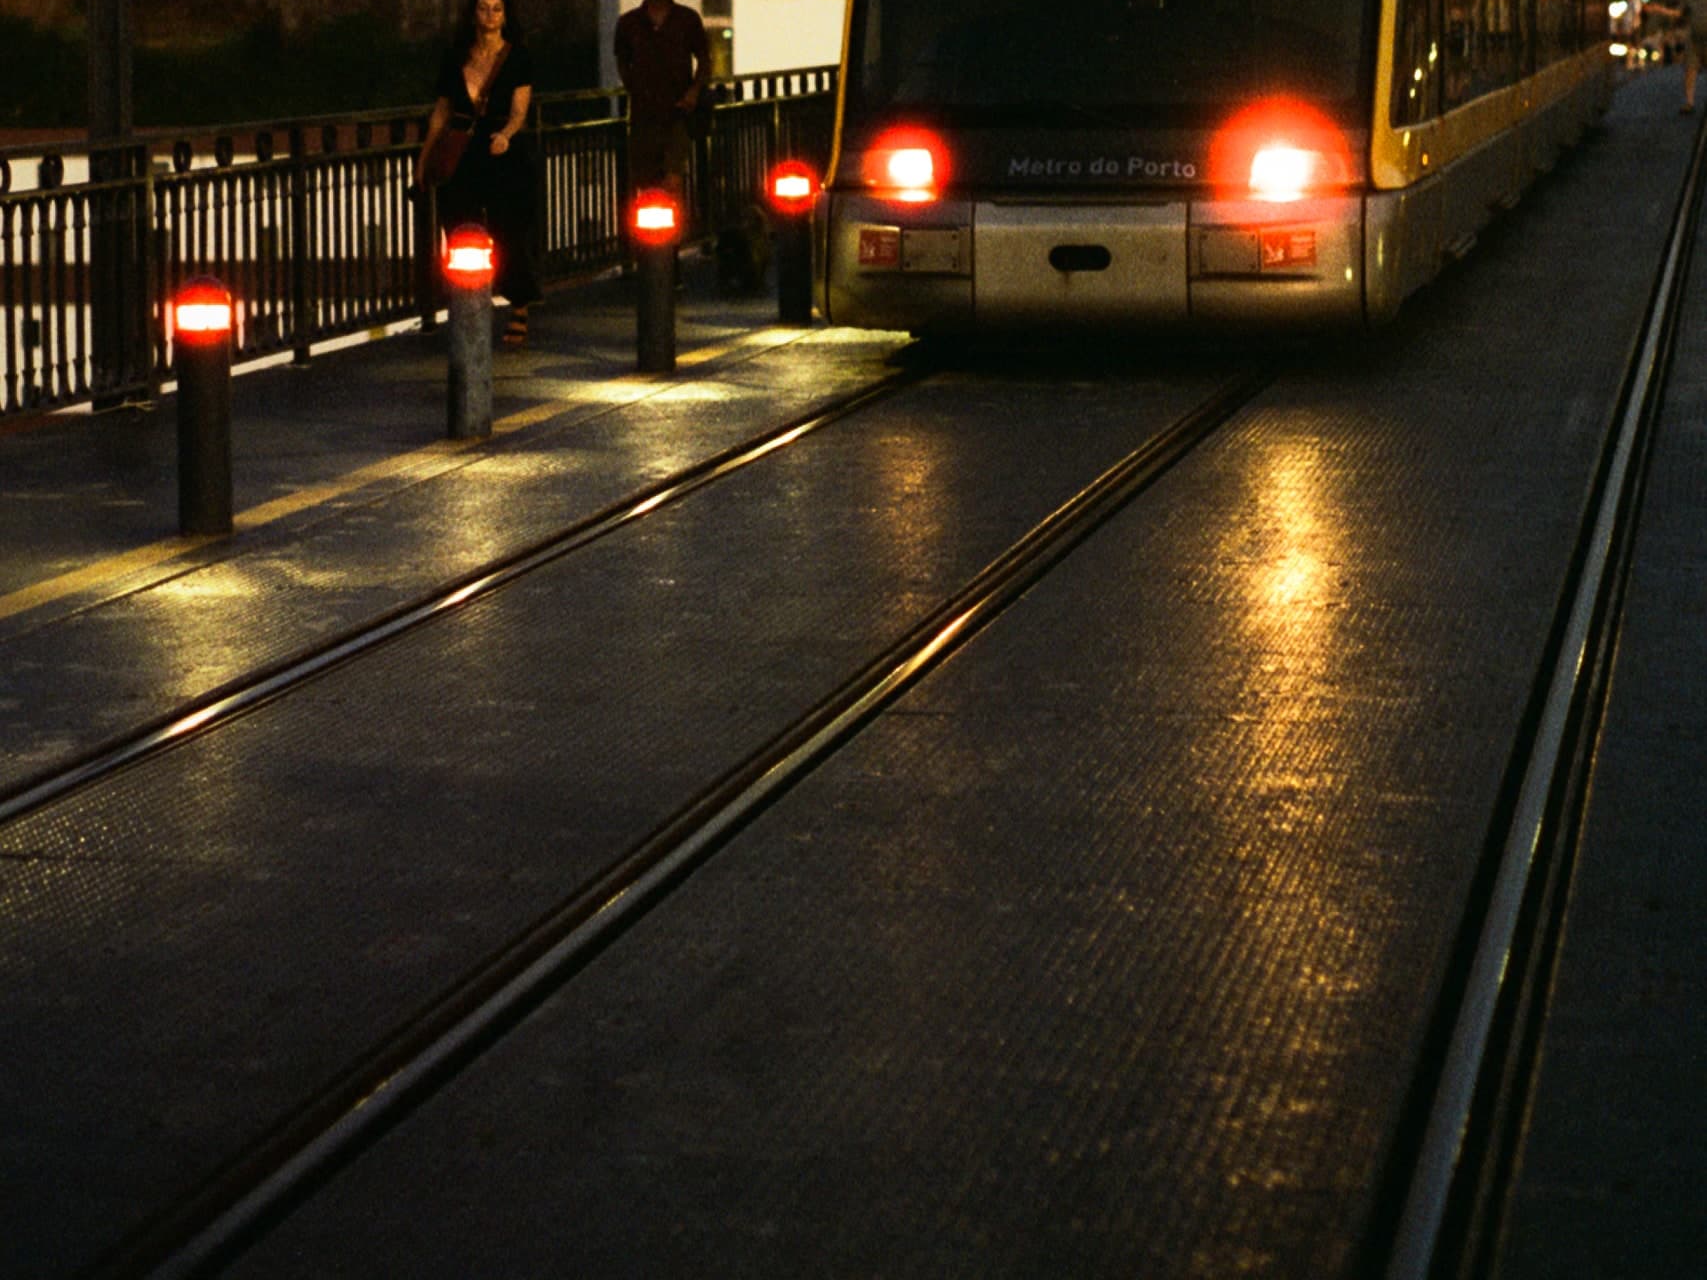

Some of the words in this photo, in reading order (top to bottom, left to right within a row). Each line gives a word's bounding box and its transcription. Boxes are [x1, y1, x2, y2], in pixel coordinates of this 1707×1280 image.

[1008, 157, 1081, 177] Metro
[1089, 157, 1120, 175] do
[1127, 157, 1196, 178] Porto
